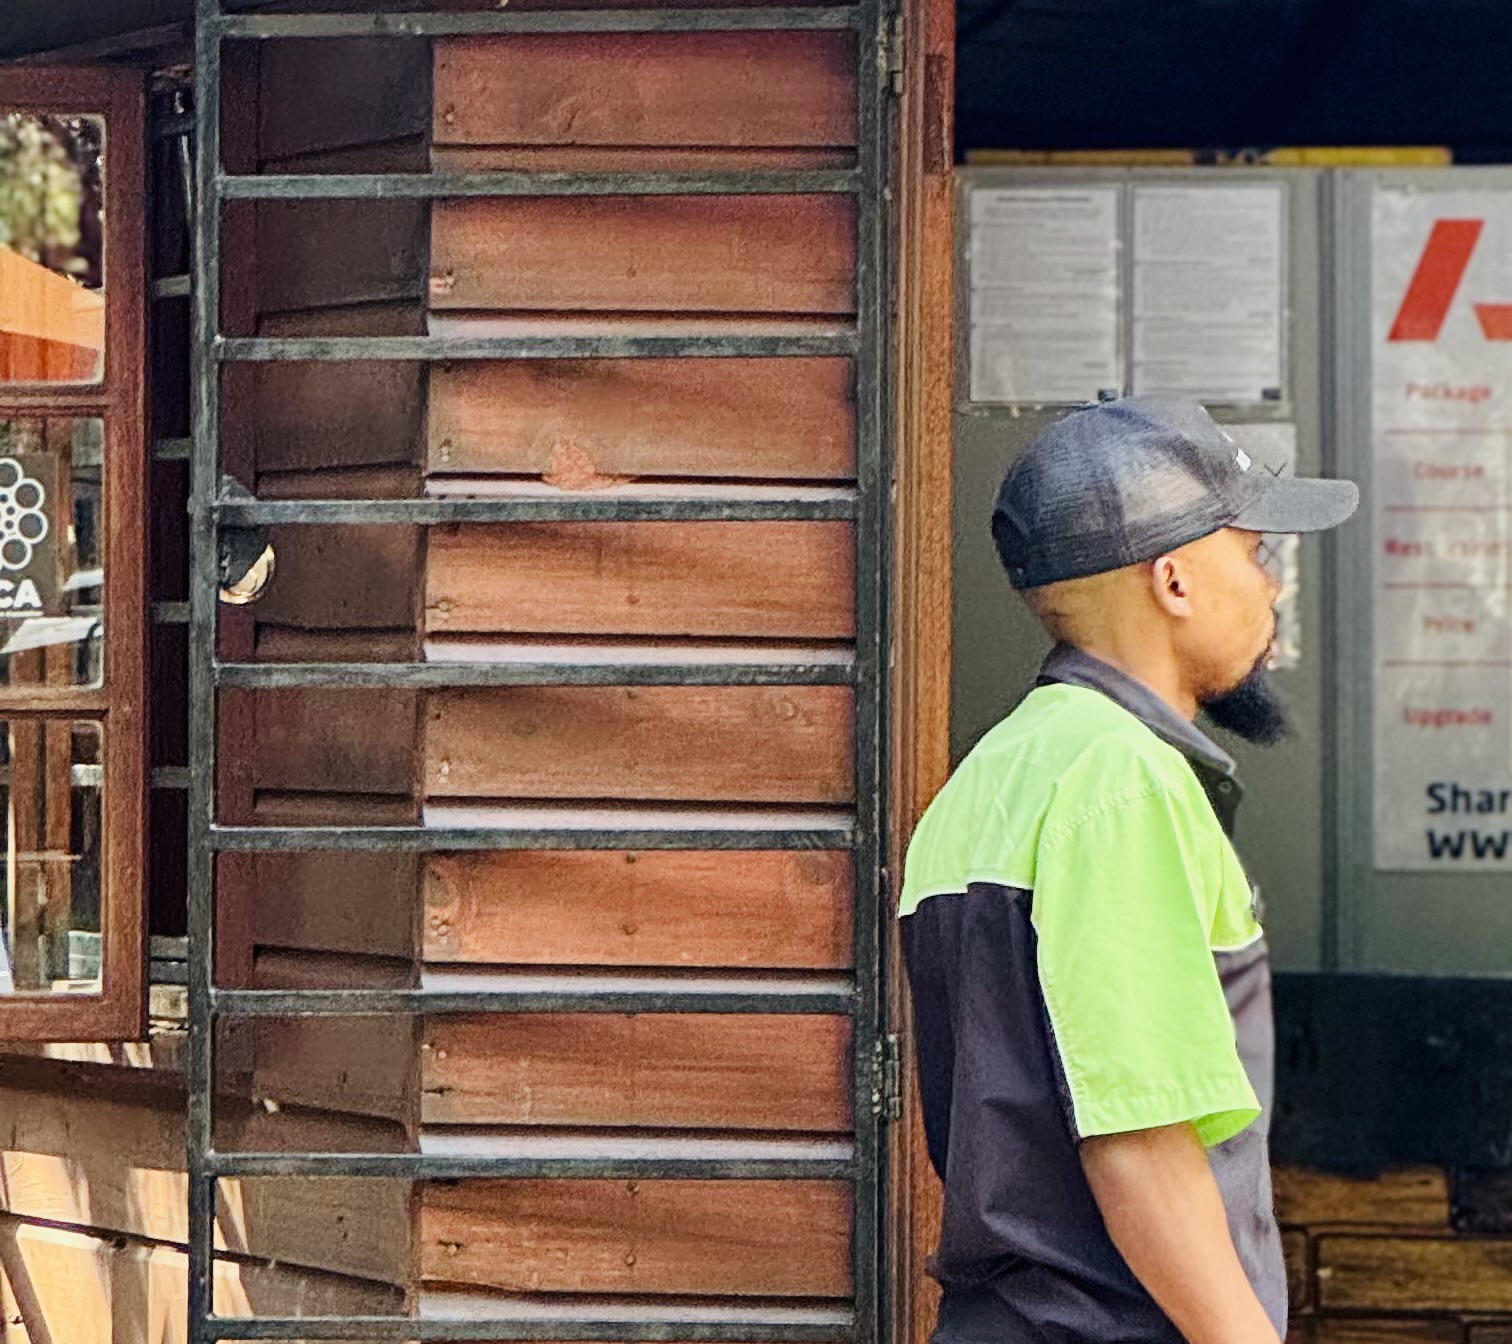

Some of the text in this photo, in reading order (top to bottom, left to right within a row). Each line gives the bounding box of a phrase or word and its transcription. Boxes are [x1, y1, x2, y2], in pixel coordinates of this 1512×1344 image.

[1406, 382, 1492, 404] Package
[1413, 462, 1485, 481] Course
[1403, 708, 1493, 728] Upgrade
